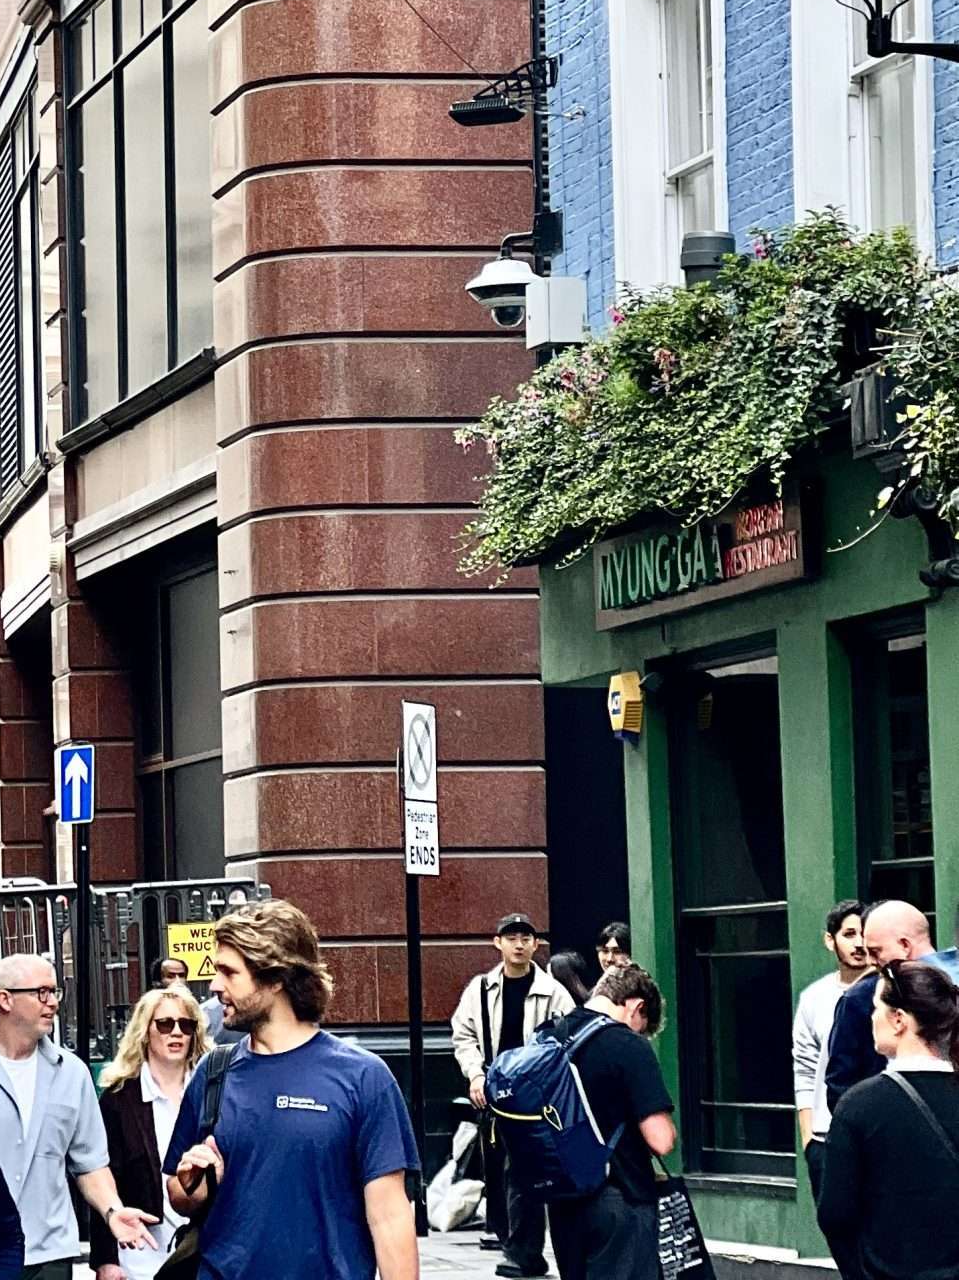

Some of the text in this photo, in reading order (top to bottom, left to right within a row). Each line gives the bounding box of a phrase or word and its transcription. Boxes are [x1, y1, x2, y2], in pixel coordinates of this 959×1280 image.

[737, 499, 783, 541] KOREAN
[723, 530, 798, 578] RESTAURANT
[410, 845, 436, 866] ENDS
[190, 928, 215, 938] WEA
[173, 941, 215, 952] STRUC
